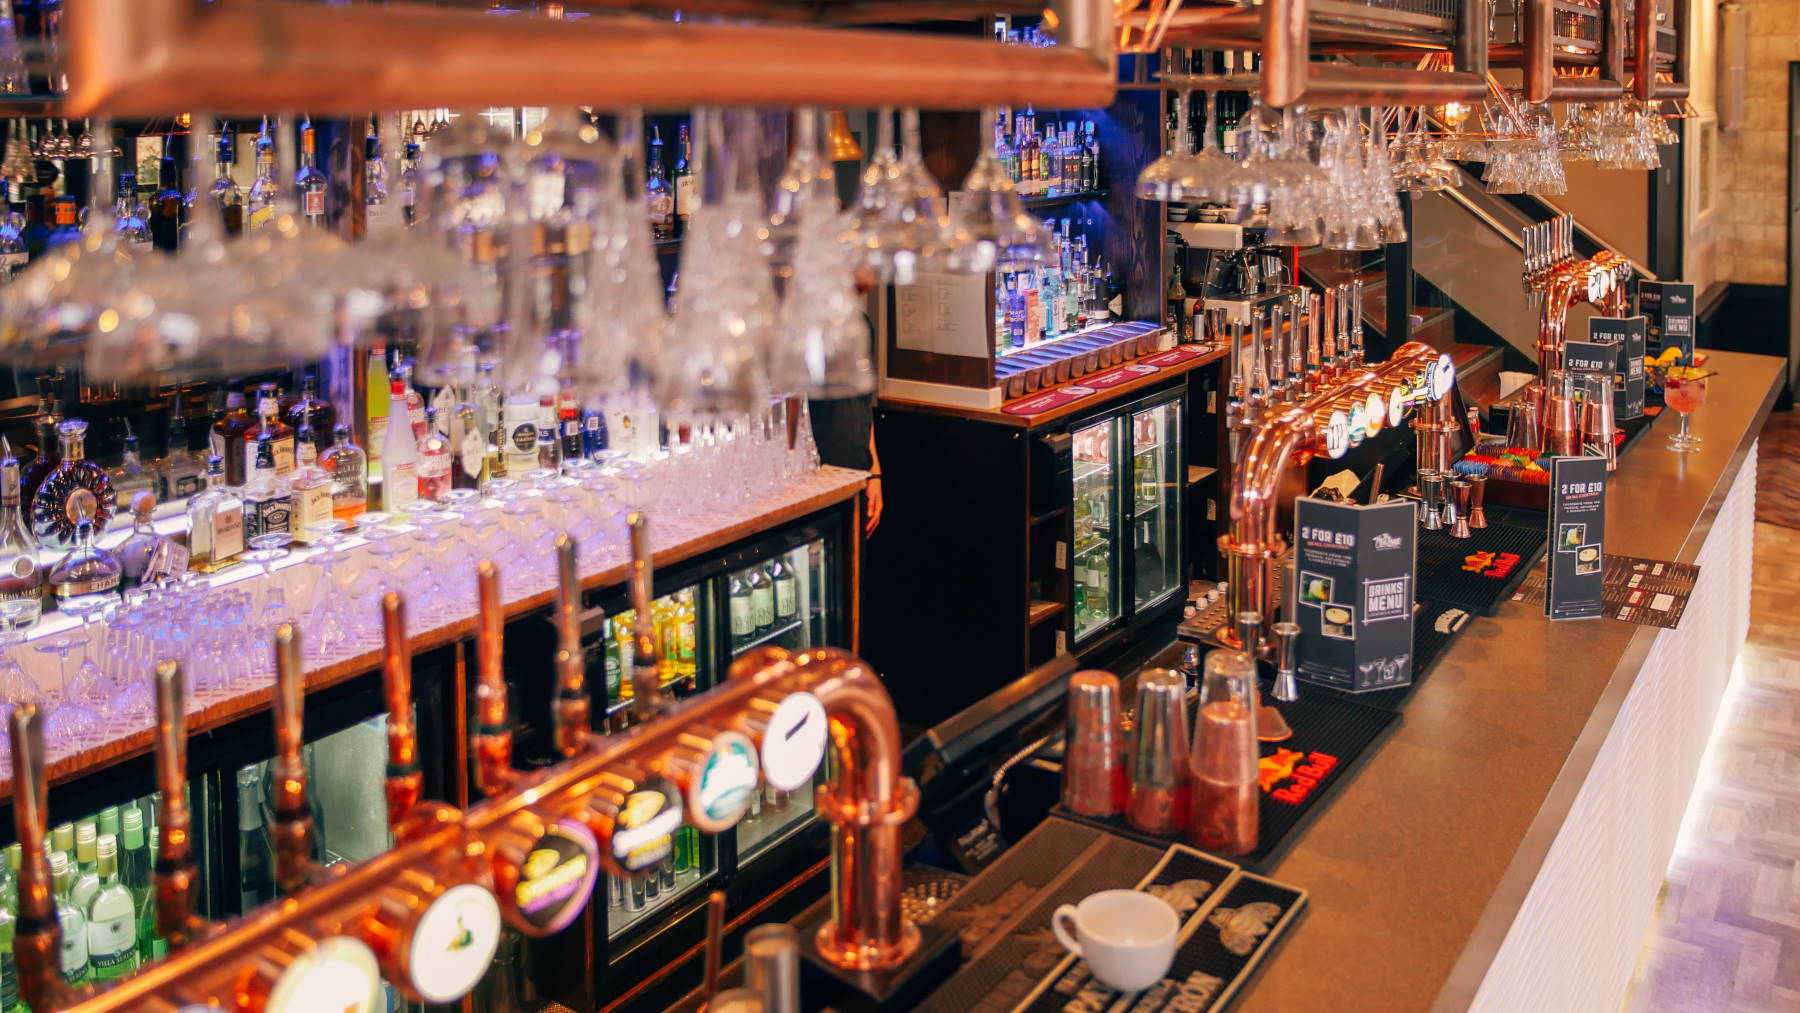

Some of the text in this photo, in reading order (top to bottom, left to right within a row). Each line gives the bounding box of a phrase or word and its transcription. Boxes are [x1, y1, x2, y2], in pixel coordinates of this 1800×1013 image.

[1593, 332, 1598, 340] 2
[1599, 332, 1612, 340] FOR
[1568, 358, 1574, 367] 2
[1575, 359, 1588, 368] FOR
[1590, 360, 1603, 369] £10
[1561, 481, 1603, 495] 2 FOR £10
[1301, 526, 1310, 539] 2
[1311, 528, 1332, 543] FOR
[1334, 532, 1356, 547] £10
[1368, 582, 1404, 597] DRINKS
[1368, 593, 1404, 612] MENU
